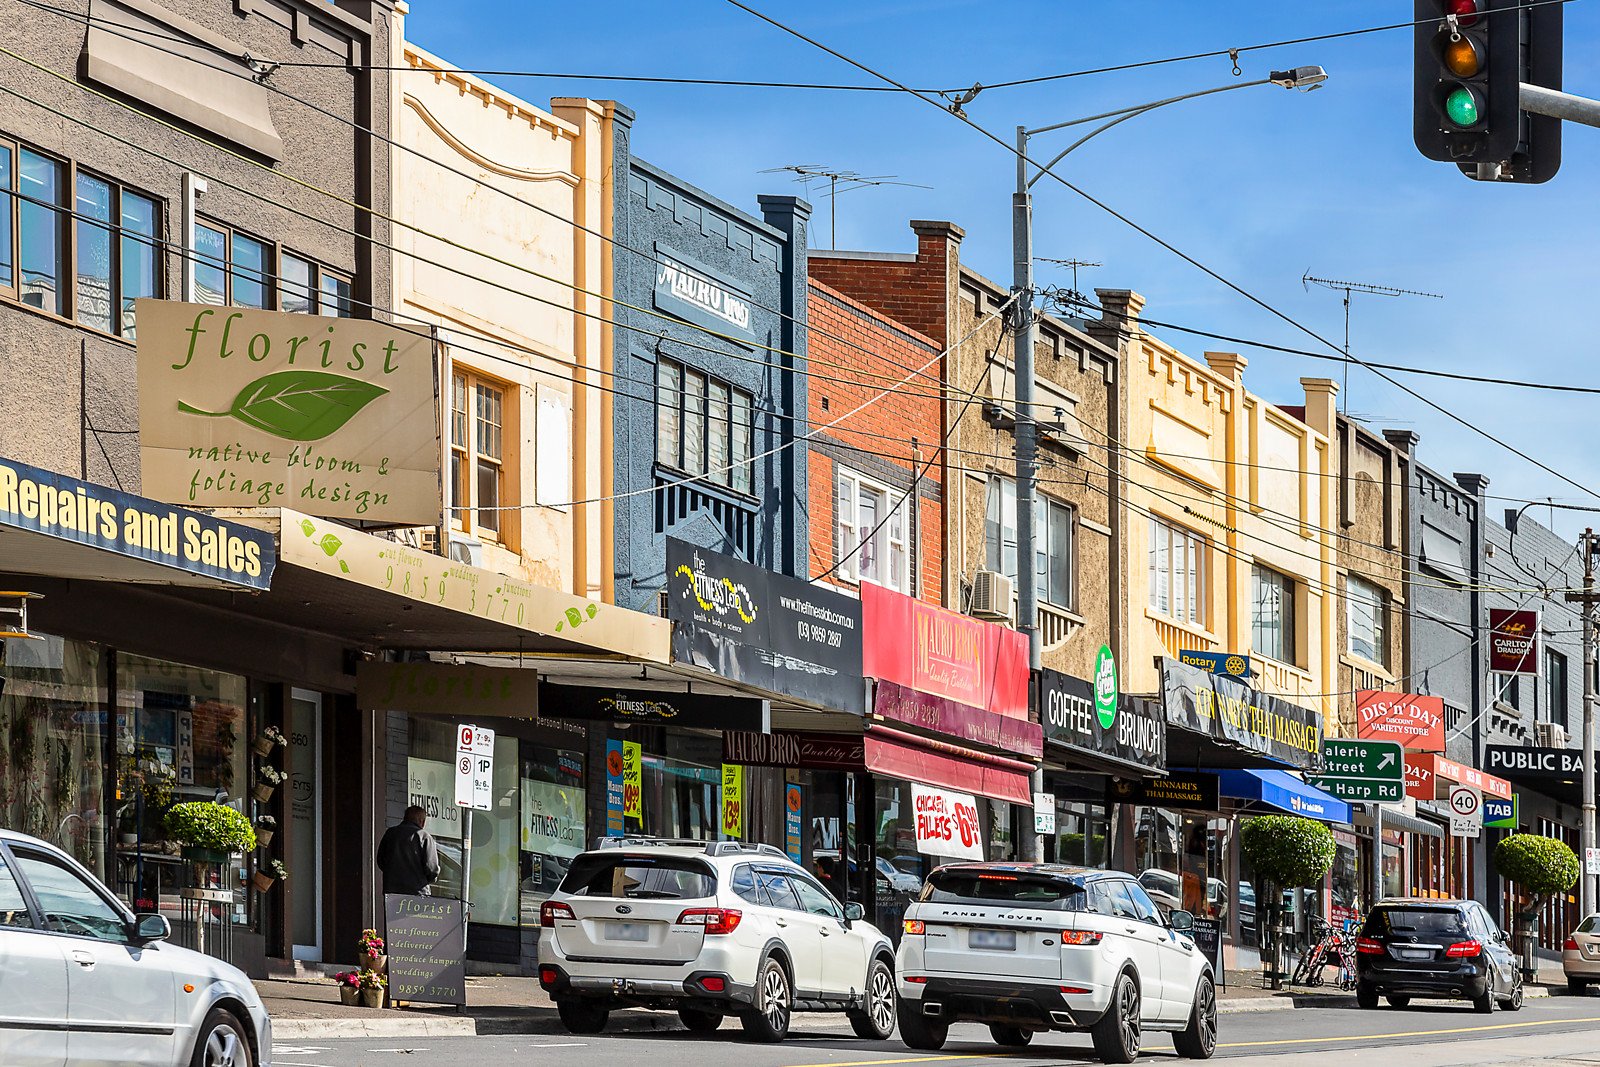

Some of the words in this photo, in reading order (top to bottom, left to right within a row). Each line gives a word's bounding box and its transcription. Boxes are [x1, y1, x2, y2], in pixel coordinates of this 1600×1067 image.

[171, 309, 401, 375] florist
[188, 443, 271, 465] native
[287, 445, 362, 474] bloom
[378, 456, 390, 476] &
[188, 469, 285, 505] foliage
[301, 477, 390, 513] design
[0, 464, 118, 540] Repairs
[124, 508, 178, 557] and
[183, 516, 262, 578] Sales
[398, 547, 424, 568] flowers
[693, 549, 706, 572] the
[449, 566, 480, 587] weddings
[385, 565, 447, 604] 9859
[468, 589, 525, 626] 3770
[503, 578, 532, 599] functions
[694, 572, 725, 606] FITNESS
[725, 588, 743, 610] Lab
[693, 610, 707, 623] health
[711, 617, 723, 630] body
[727, 622, 742, 634] science
[797, 621, 811, 642] (03)
[811, 626, 826, 644] 9859
[827, 632, 843, 649] 2887
[1494, 638, 1533, 650] CARLTON
[917, 610, 953, 674] MAURO
[954, 624, 981, 688] BROS
[1496, 646, 1531, 656] DRAUGHT
[1182, 655, 1217, 671] Rotary
[382, 663, 512, 704] florist
[929, 663, 951, 692] Quality
[616, 691, 627, 700] the
[616, 700, 645, 712] FITNESS
[1048, 688, 1093, 736] COFFEE
[1118, 710, 1161, 755] BRUNCH
[1249, 705, 1274, 741] THAI
[1361, 702, 1387, 722] DIS
[1409, 705, 1441, 730] DAT
[1386, 716, 1414, 726] DISCOUNT
[461, 727, 473, 745] C
[537, 716, 562, 729] personal
[563, 722, 586, 738] training
[1370, 723, 1403, 734] VARIETY
[1404, 726, 1430, 737] STORE
[726, 730, 767, 763] MAURO
[769, 733, 800, 765] BROS
[801, 743, 846, 761] Quality
[1325, 745, 1368, 758] alerie
[478, 759, 490, 773] 1P
[1490, 750, 1556, 771] PUBLIC
[1562, 754, 1597, 773] BA
[410, 771, 422, 790] the
[1404, 763, 1432, 781] DAT
[1153, 780, 1198, 791] KINNARI'S
[1336, 783, 1371, 798] Harp
[1378, 784, 1397, 797] Rd
[531, 795, 543, 811] the
[916, 794, 949, 814] CHICKEN
[1146, 790, 1164, 798] THAI
[1166, 791, 1203, 801] MASSAGE
[1455, 797, 1474, 809] 40
[441, 797, 458, 822] Lab
[1486, 803, 1512, 817] TAB
[530, 813, 559, 838] FITNESS
[917, 813, 952, 841] FILLETS
[395, 899, 452, 914] florist
[942, 910, 986, 918] RANGE
[997, 913, 1043, 922] ROVER
[409, 928, 440, 937] flowers
[1194, 920, 1212, 928] NARI'S
[395, 941, 433, 950] deliveries
[395, 955, 426, 964] produce
[428, 955, 462, 967] hampers
[397, 968, 434, 979] weddings
[399, 984, 426, 995] 9859
[430, 986, 457, 997] 3770
